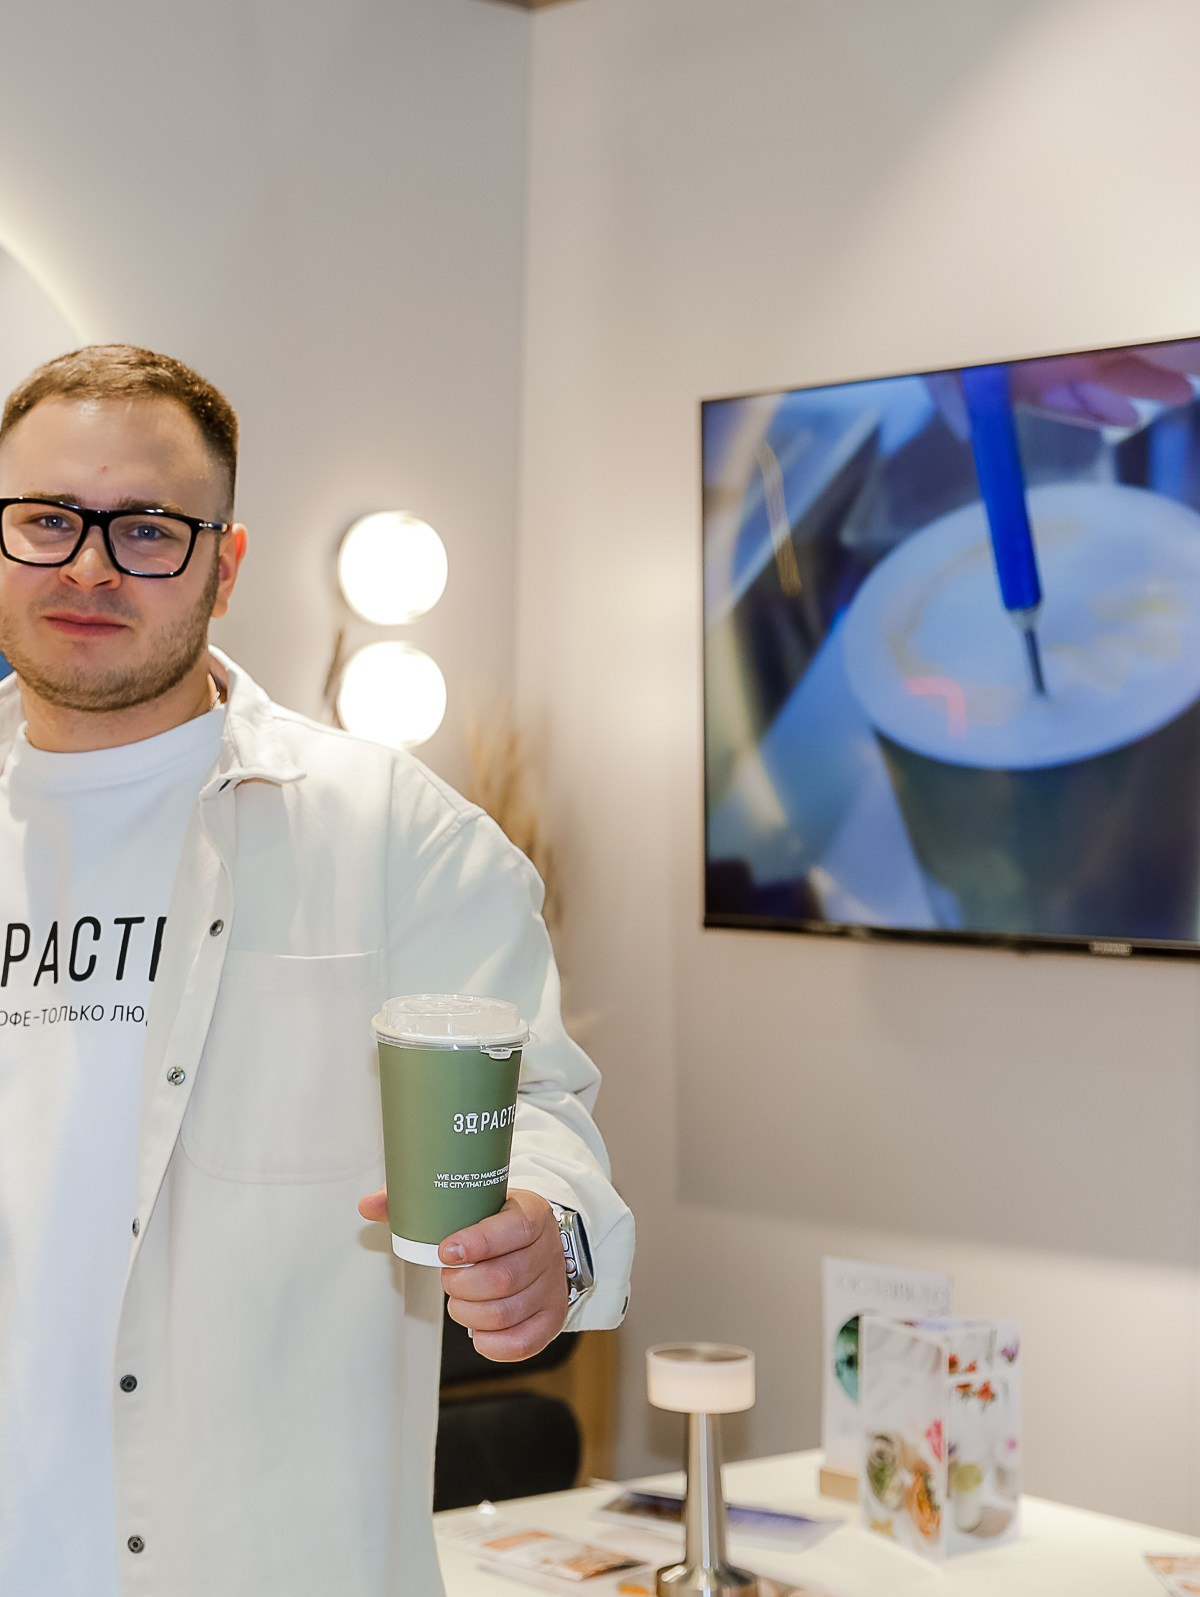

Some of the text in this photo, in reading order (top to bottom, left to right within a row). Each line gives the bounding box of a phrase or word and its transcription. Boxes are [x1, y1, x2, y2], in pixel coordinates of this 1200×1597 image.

[110, 1004, 149, 1027] ЛЮ
[436, 1173, 450, 1181] WE
[450, 1173, 470, 1181] LOVE
[480, 1170, 497, 1179] MAKE
[433, 1180, 449, 1189] THE
[449, 1181, 466, 1189] CITY
[466, 1180, 483, 1189] THAT
[483, 1177, 500, 1187] LOVES
